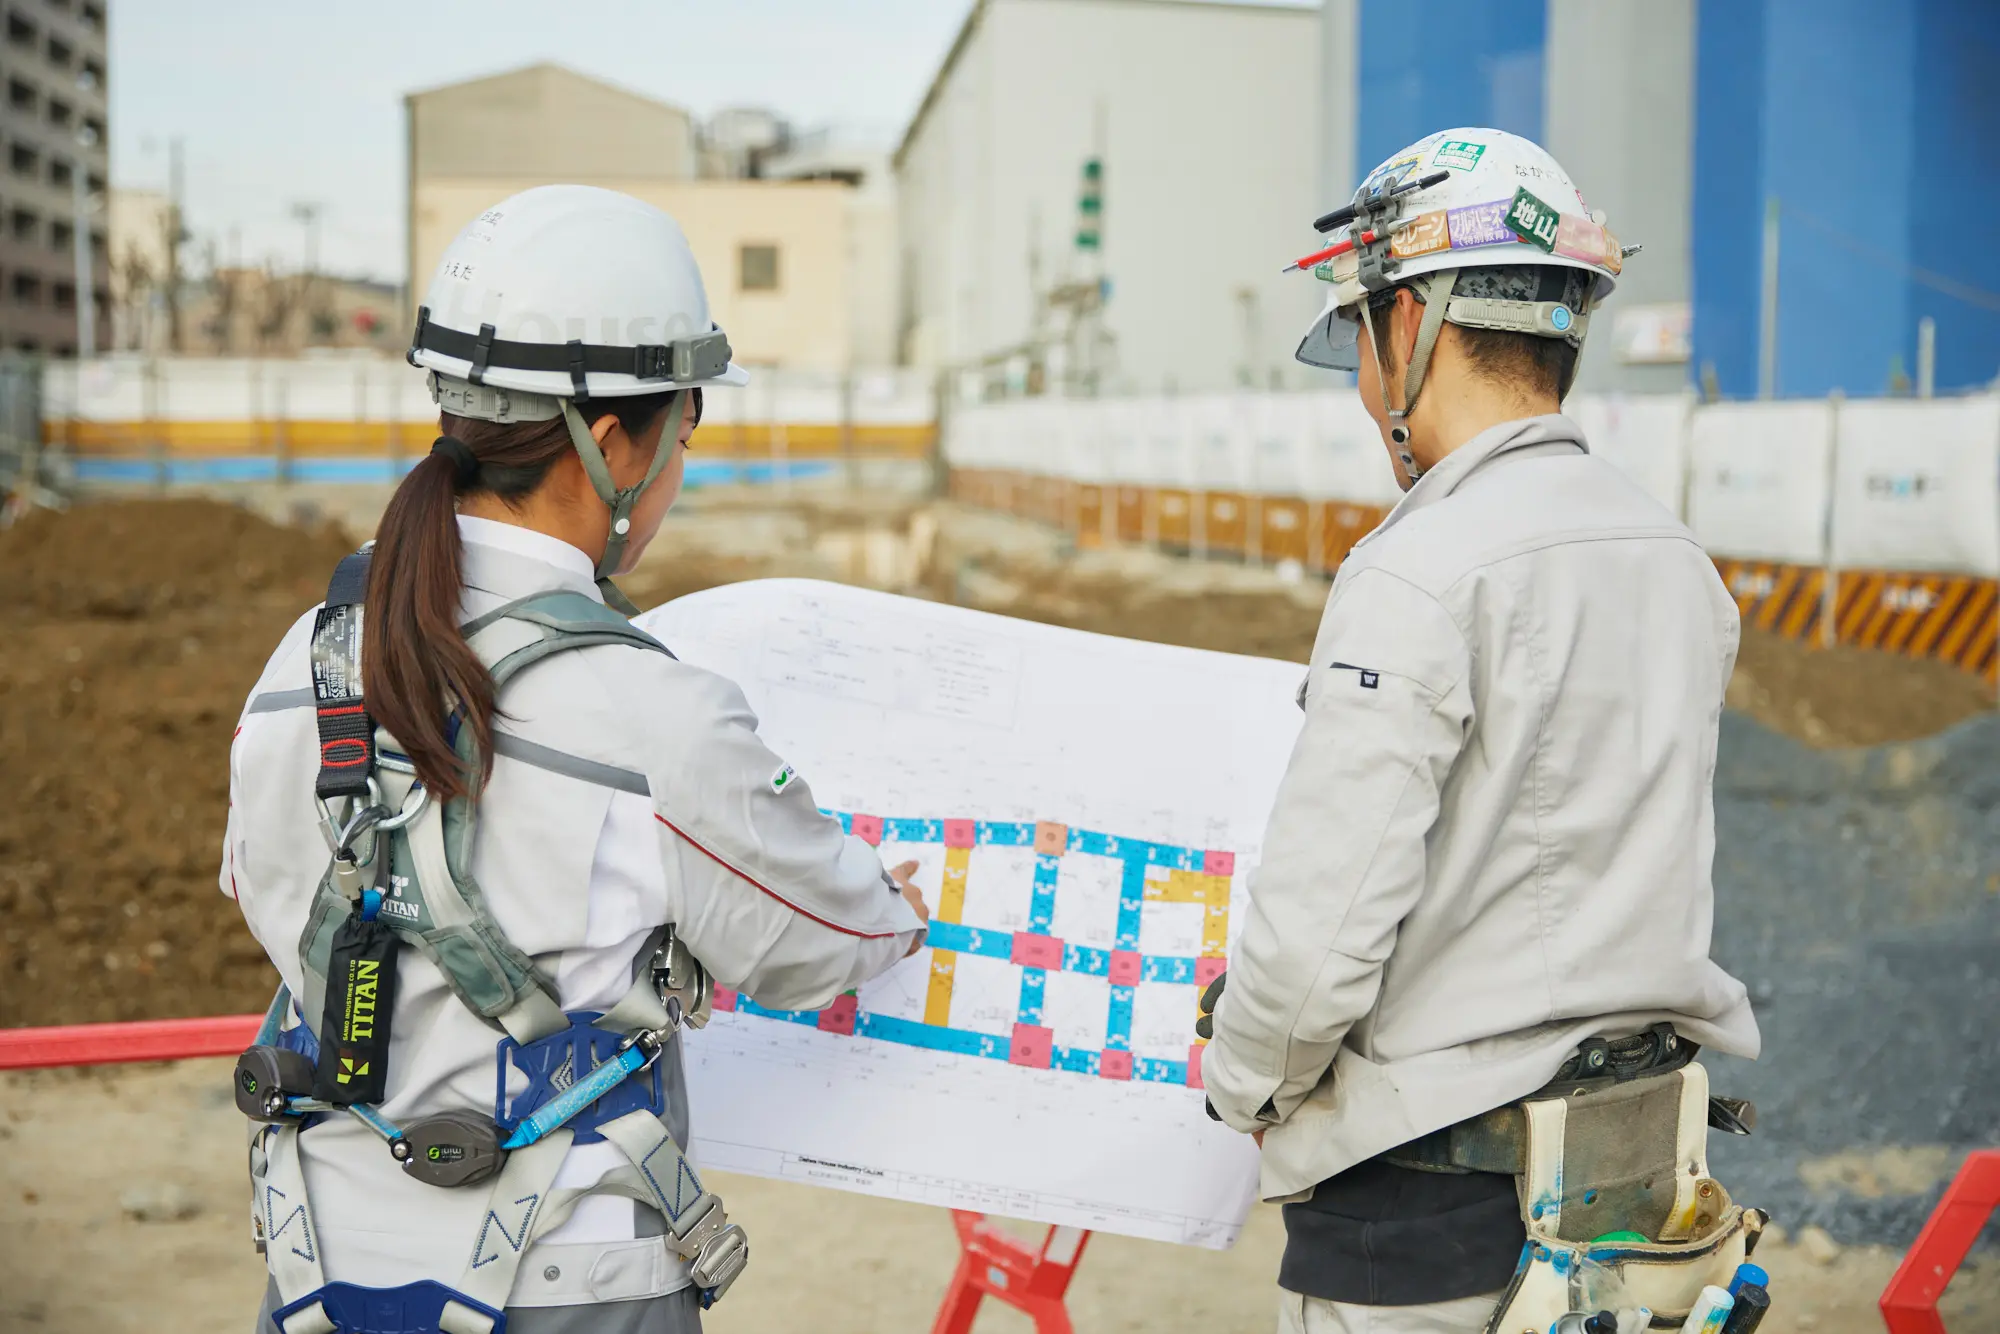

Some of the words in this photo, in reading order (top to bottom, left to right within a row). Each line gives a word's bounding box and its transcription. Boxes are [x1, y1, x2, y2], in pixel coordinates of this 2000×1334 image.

[1512, 197, 1558, 246] 地山
[382, 899, 419, 918] TITAN
[344, 983, 354, 1019] INDUSTRIES
[350, 960, 380, 1042] TITAN
[342, 1020, 350, 1041] SANKO
